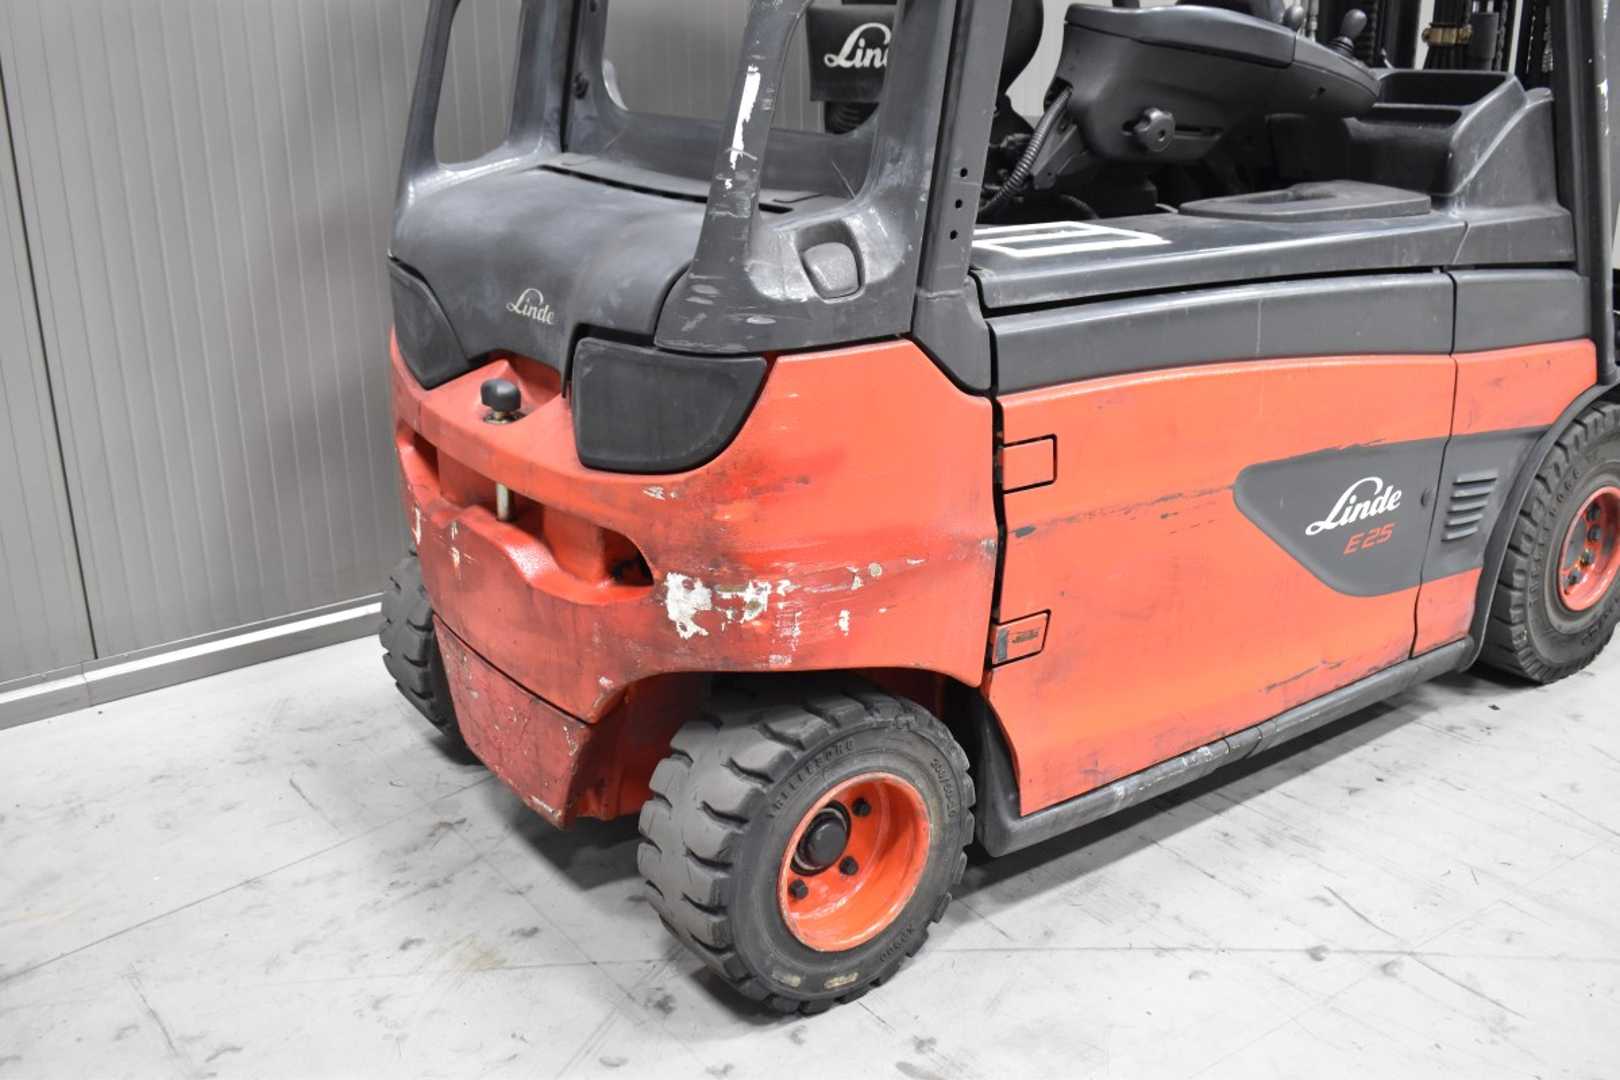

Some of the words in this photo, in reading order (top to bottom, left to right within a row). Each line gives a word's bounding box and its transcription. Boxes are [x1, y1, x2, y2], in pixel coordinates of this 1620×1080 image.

[824, 22, 891, 69] Lin
[505, 287, 555, 325] Linde
[1305, 476, 1402, 536] Linde
